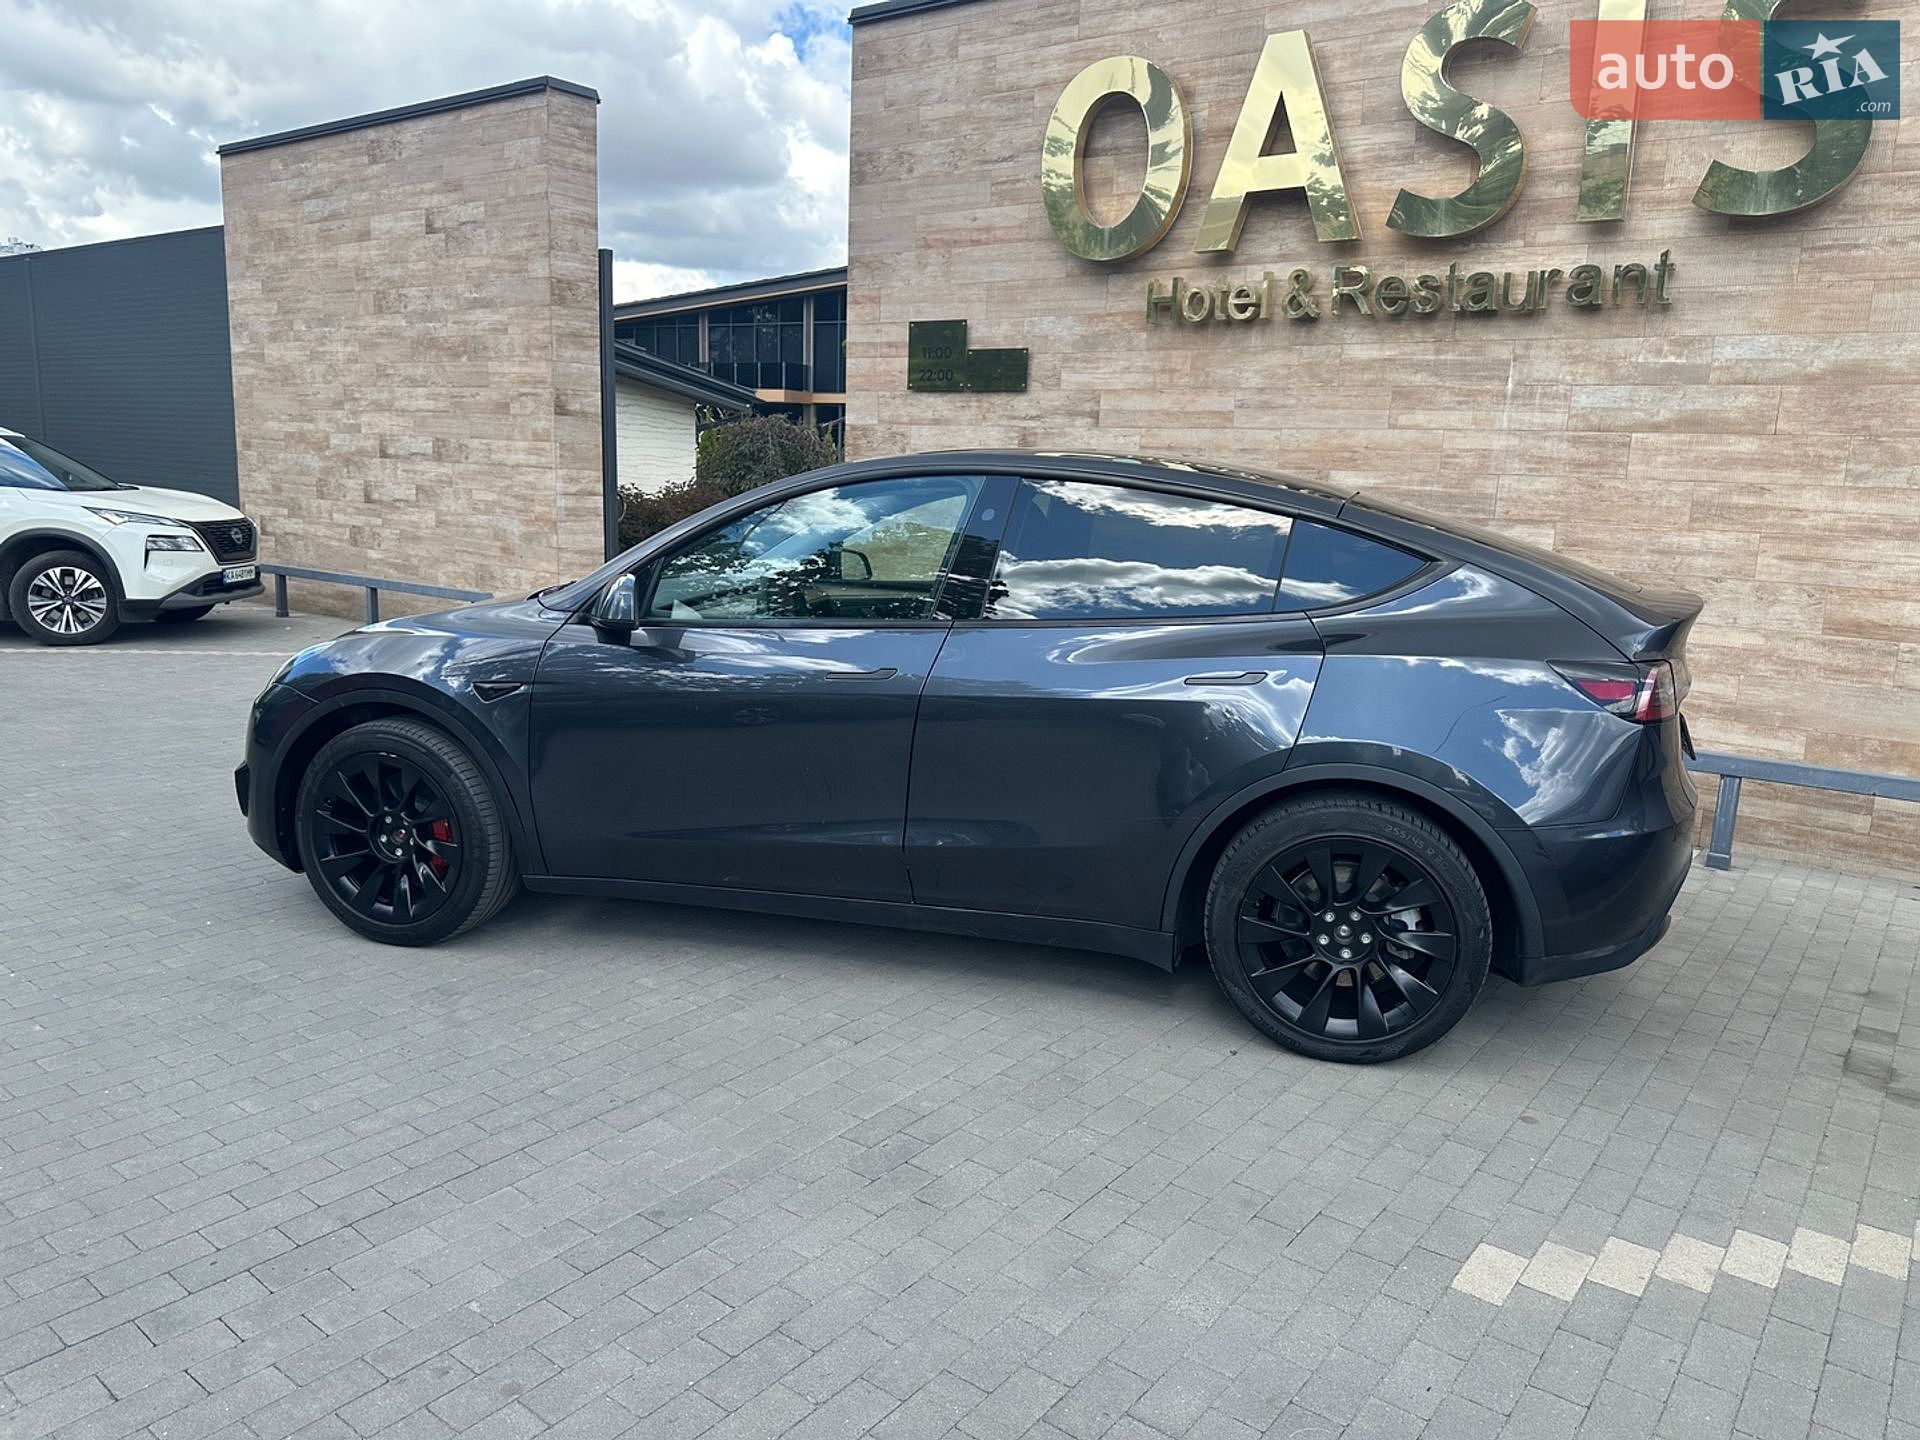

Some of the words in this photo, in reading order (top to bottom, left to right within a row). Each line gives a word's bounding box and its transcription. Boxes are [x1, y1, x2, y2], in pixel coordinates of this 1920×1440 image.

[1041, 0, 1873, 262] OASIS
[1147, 271, 1275, 324] Hotel
[1281, 268, 1321, 319] &
[1331, 248, 1678, 317] Restaurant
[919, 368, 954, 382] 22:00
[921, 346, 952, 360] 11:00
